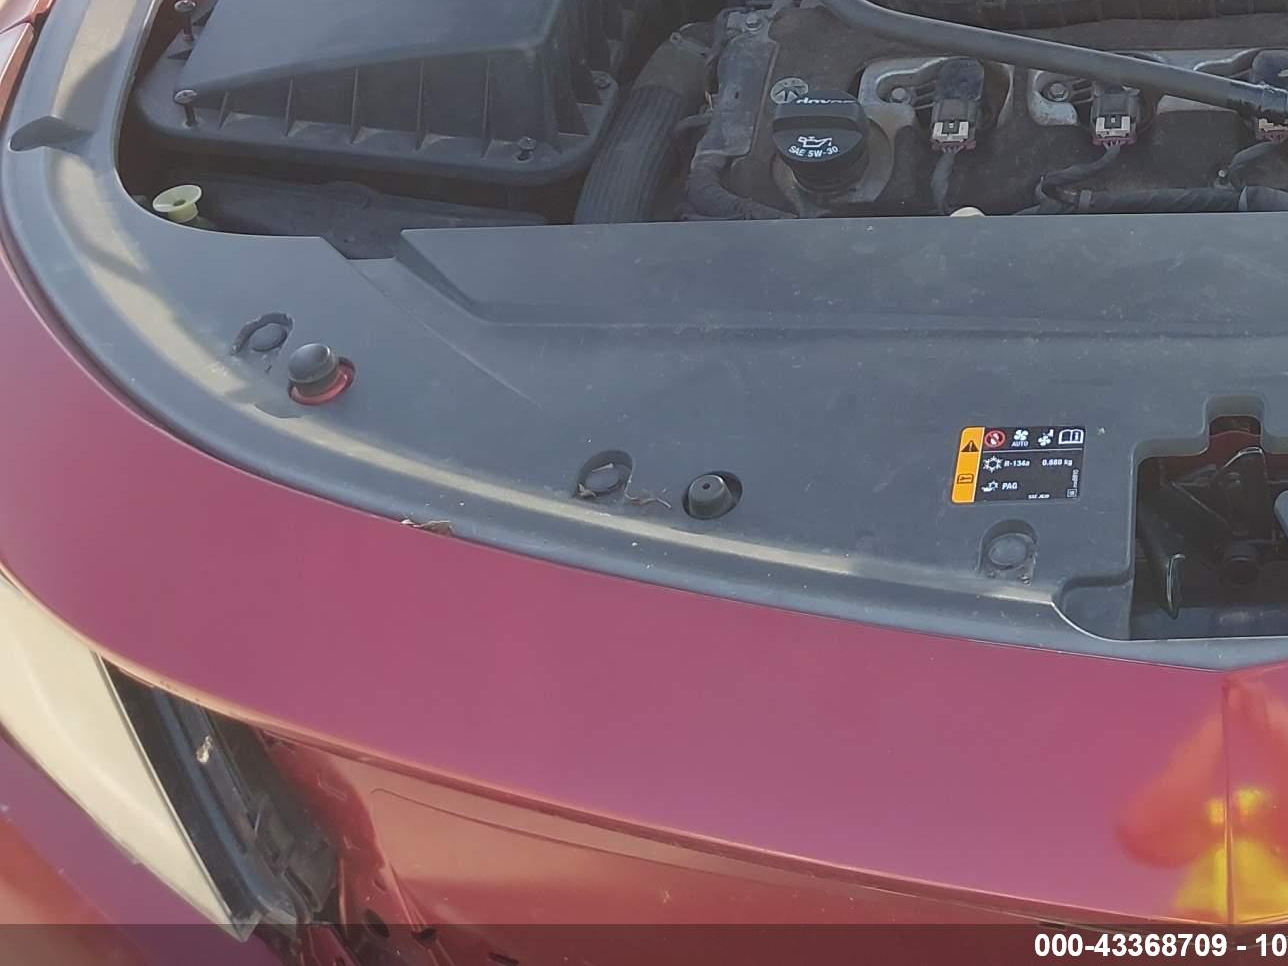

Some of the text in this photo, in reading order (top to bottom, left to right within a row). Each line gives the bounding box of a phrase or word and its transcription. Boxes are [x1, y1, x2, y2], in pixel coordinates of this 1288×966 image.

[788, 145, 839, 158] SAE 5W-30
[1002, 482, 1018, 490] PAG
